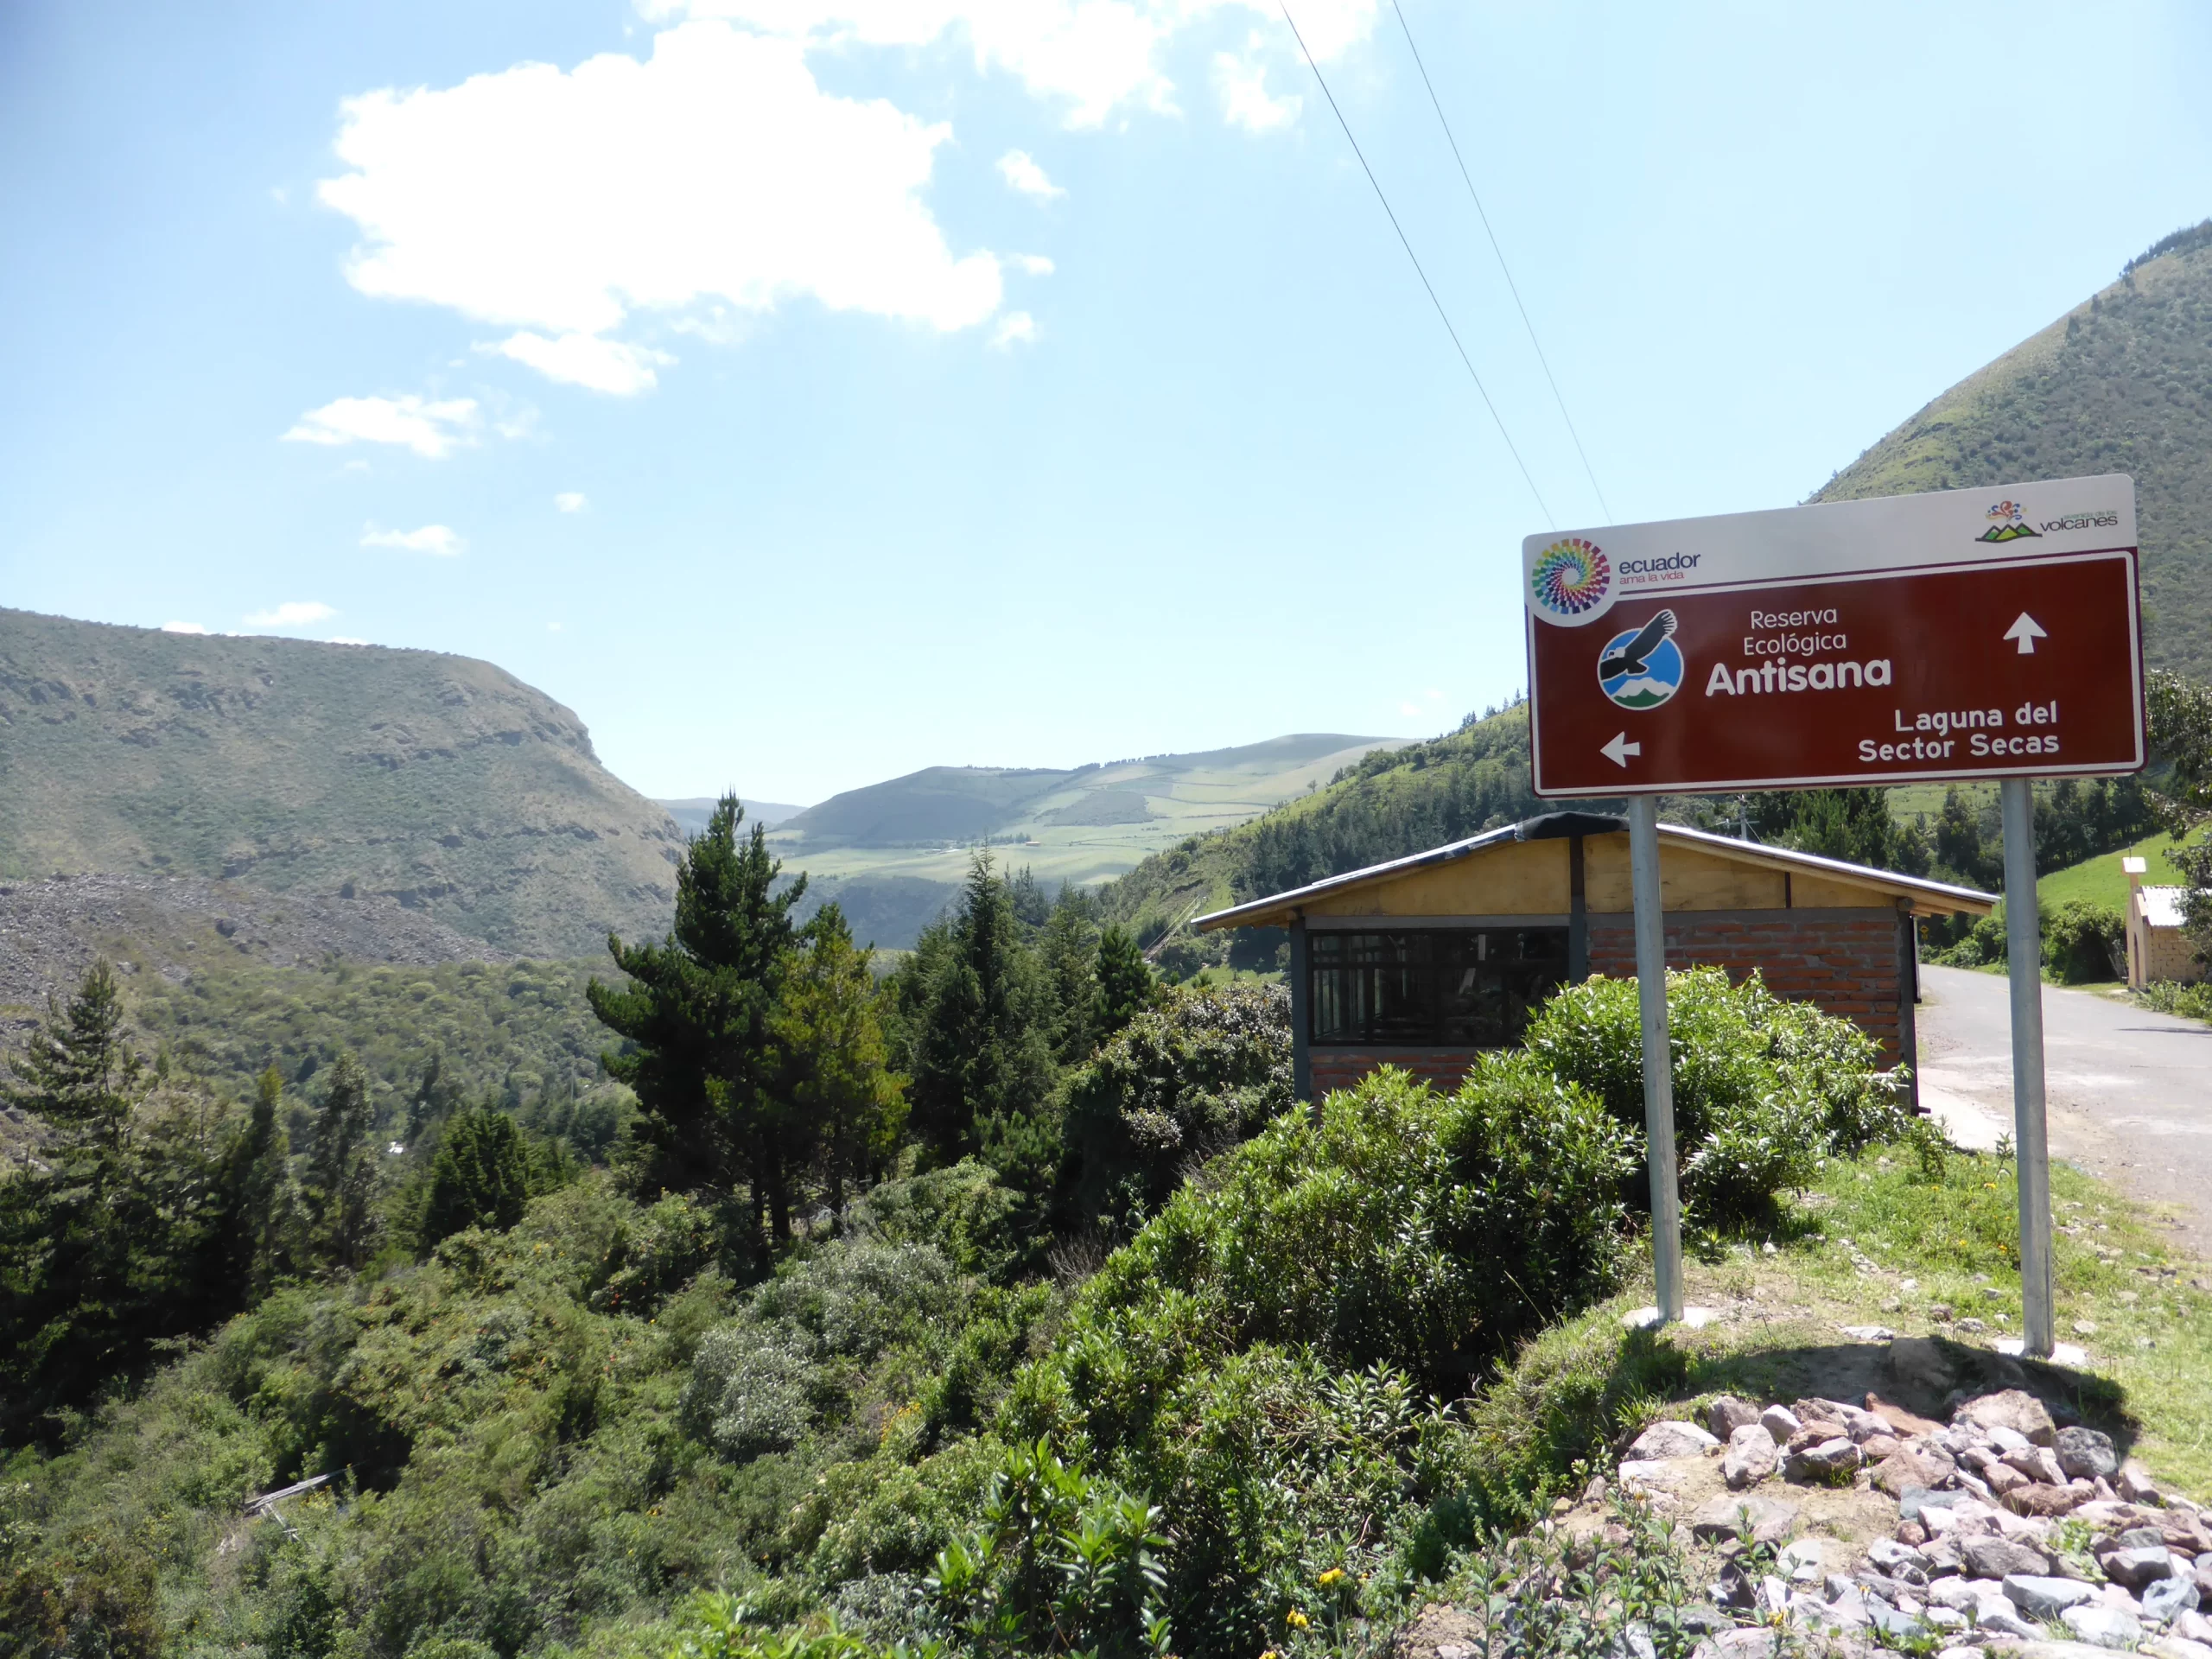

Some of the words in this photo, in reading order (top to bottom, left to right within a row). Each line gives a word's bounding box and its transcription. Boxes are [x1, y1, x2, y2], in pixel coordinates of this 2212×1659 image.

[2040, 515, 2118, 532] volcanes
[1619, 552, 1700, 575] ecuador
[1619, 575, 1645, 585] ama
[1648, 572, 1658, 582] la
[1661, 570, 1684, 581] vida
[1751, 608, 1837, 629] Reserva
[1744, 631, 1847, 657] Ecológica
[1705, 657, 1891, 696] Antisana
[1895, 709, 2003, 737] Laguna
[2015, 700, 2056, 725] del
[1859, 736, 1955, 762] Sector
[1970, 734, 2060, 757] Secas
